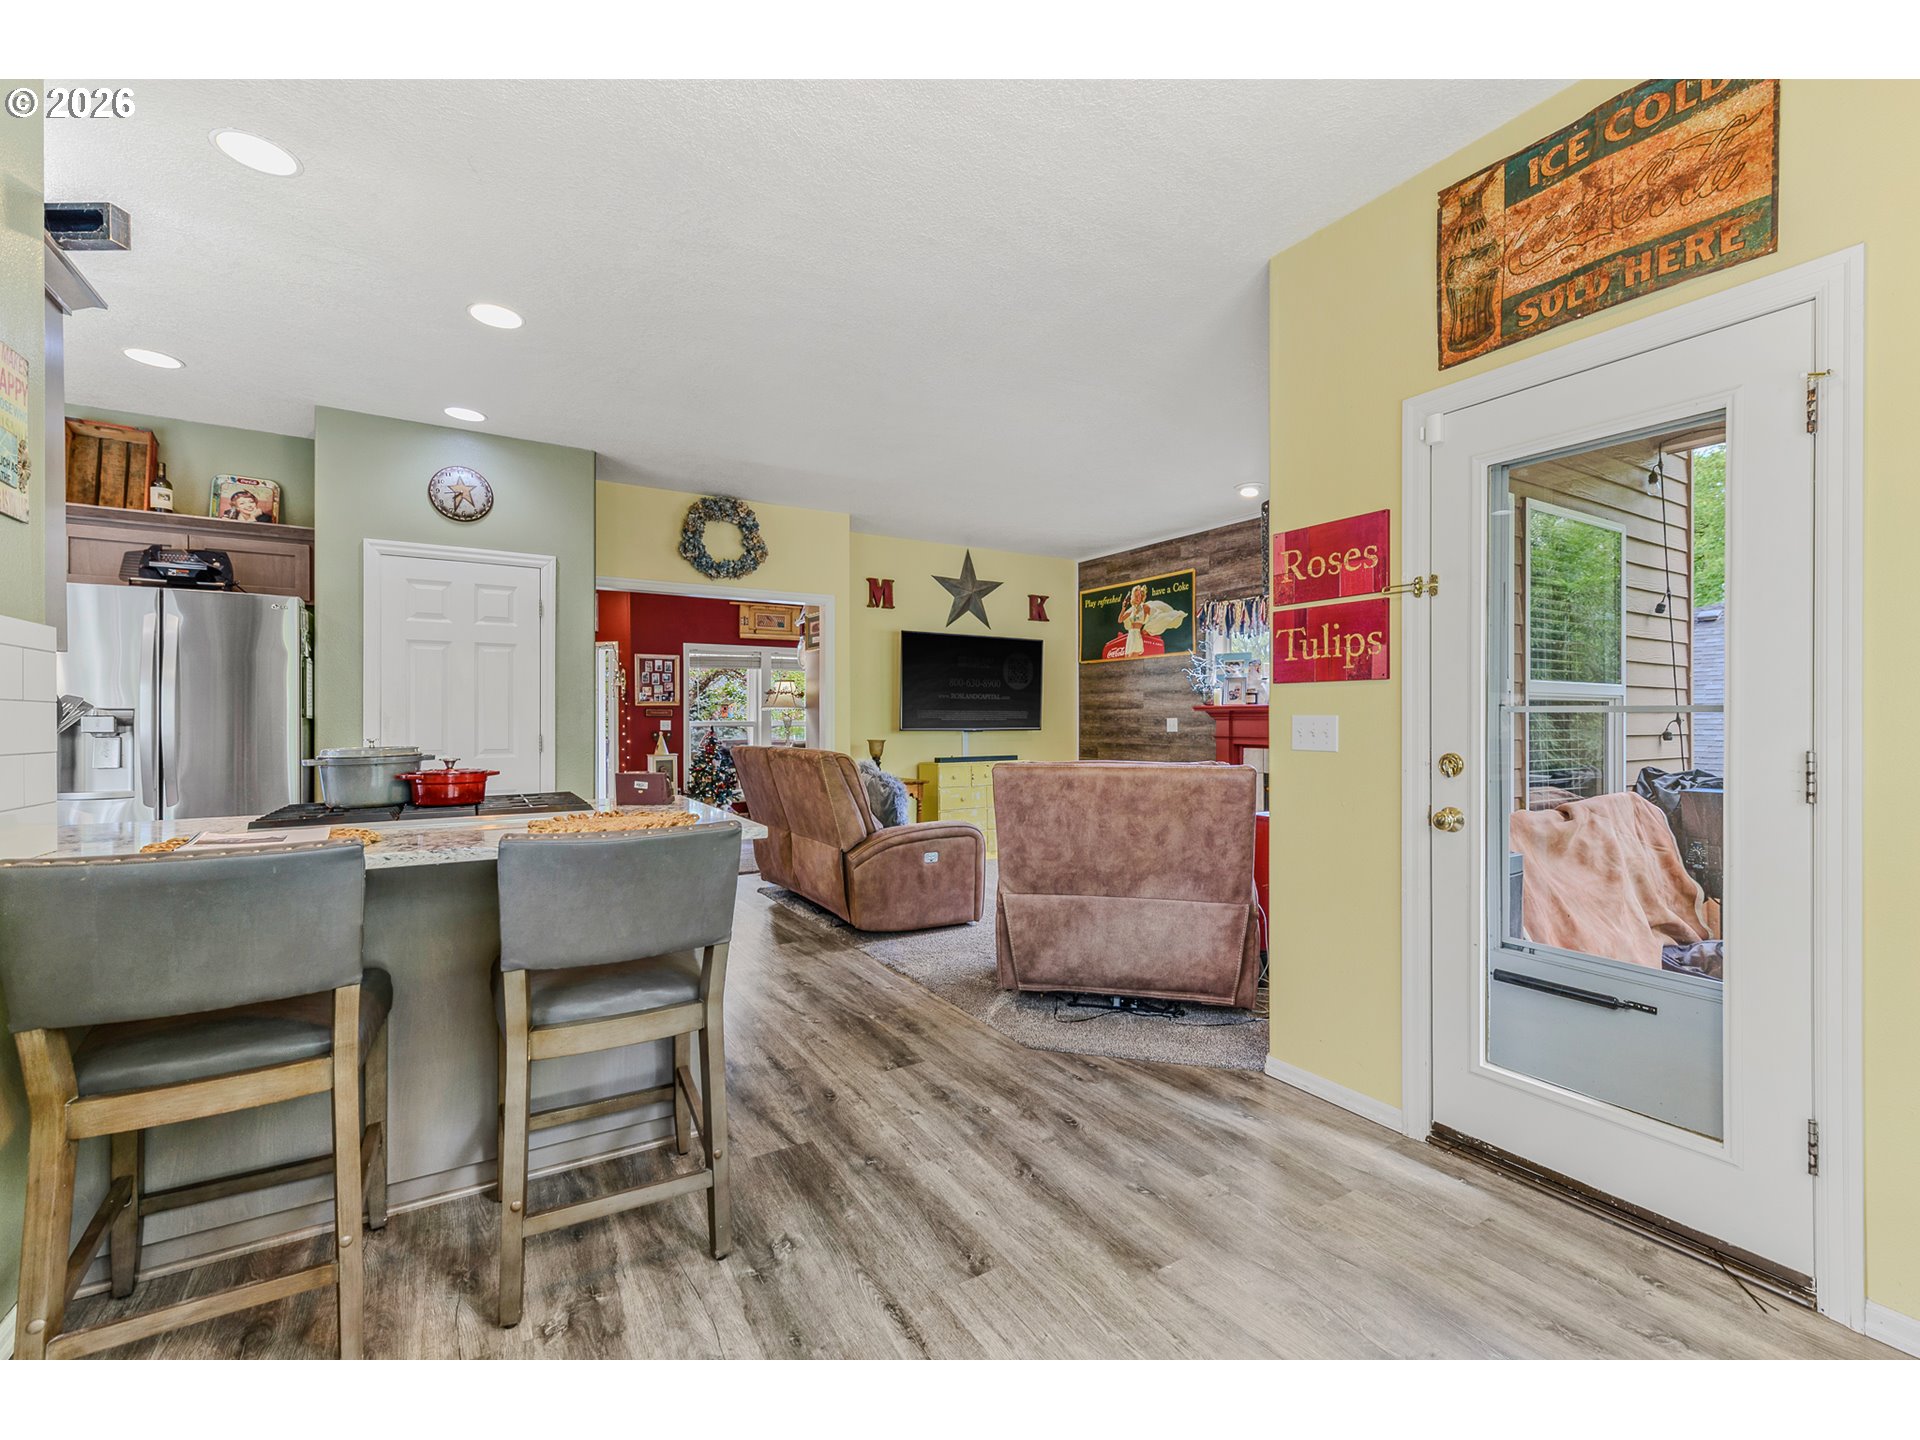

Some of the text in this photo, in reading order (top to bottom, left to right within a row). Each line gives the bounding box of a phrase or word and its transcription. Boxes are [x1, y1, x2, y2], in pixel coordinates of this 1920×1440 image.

[1527, 79, 1730, 188] ICE COLD
[1515, 218, 1747, 328] SOLD HERE
[1280, 545, 1379, 584] Roses
[866, 577, 896, 609] M
[1084, 594, 1122, 609] Play refreshed
[1151, 587, 1166, 597] have
[1172, 581, 1189, 592] Coke
[1027, 594, 1050, 622] K
[1276, 623, 1383, 669] Tulips
